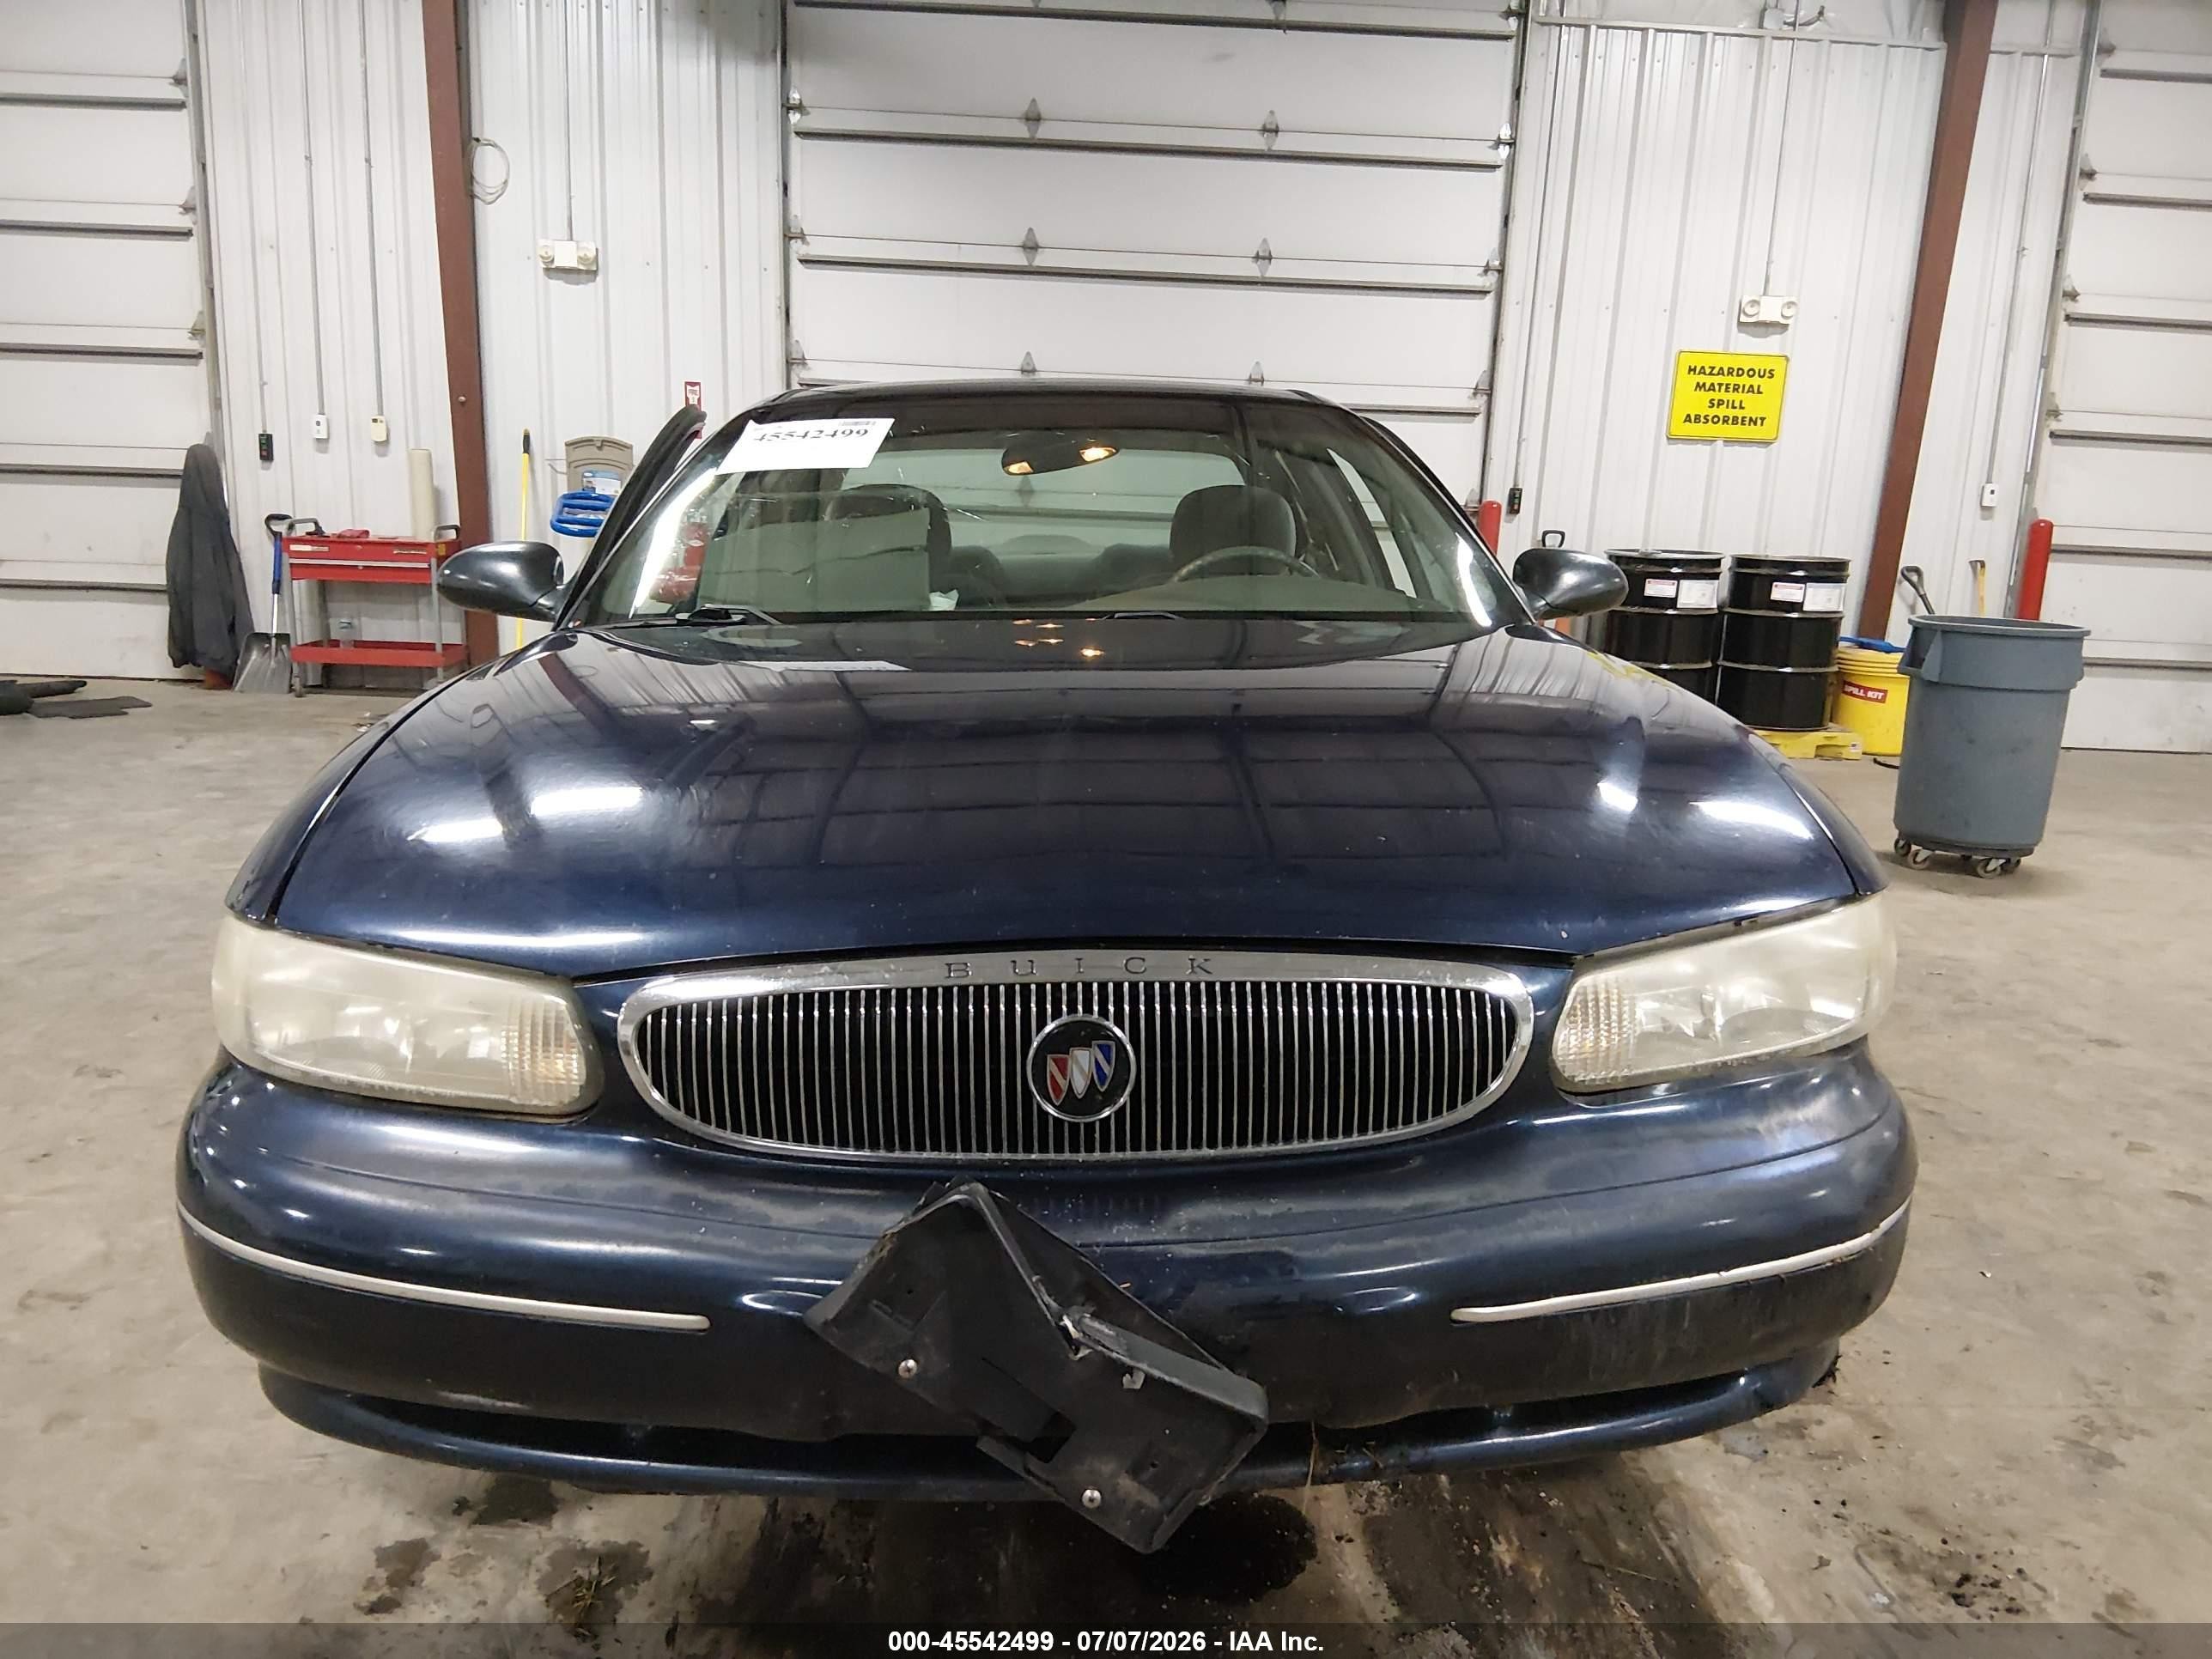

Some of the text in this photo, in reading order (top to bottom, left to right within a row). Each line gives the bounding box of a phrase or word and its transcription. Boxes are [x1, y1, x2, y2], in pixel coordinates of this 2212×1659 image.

[1687, 365, 1776, 379] HAZARDOUS
[1693, 381, 1764, 395] MATERIAL
[1708, 398, 1746, 410] SPILL
[1683, 413, 1767, 427] ABSORBENT
[754, 428, 869, 442] 45542499
[1844, 684, 1885, 700] SPILL KIT
[945, 957, 1213, 979] BUICK
